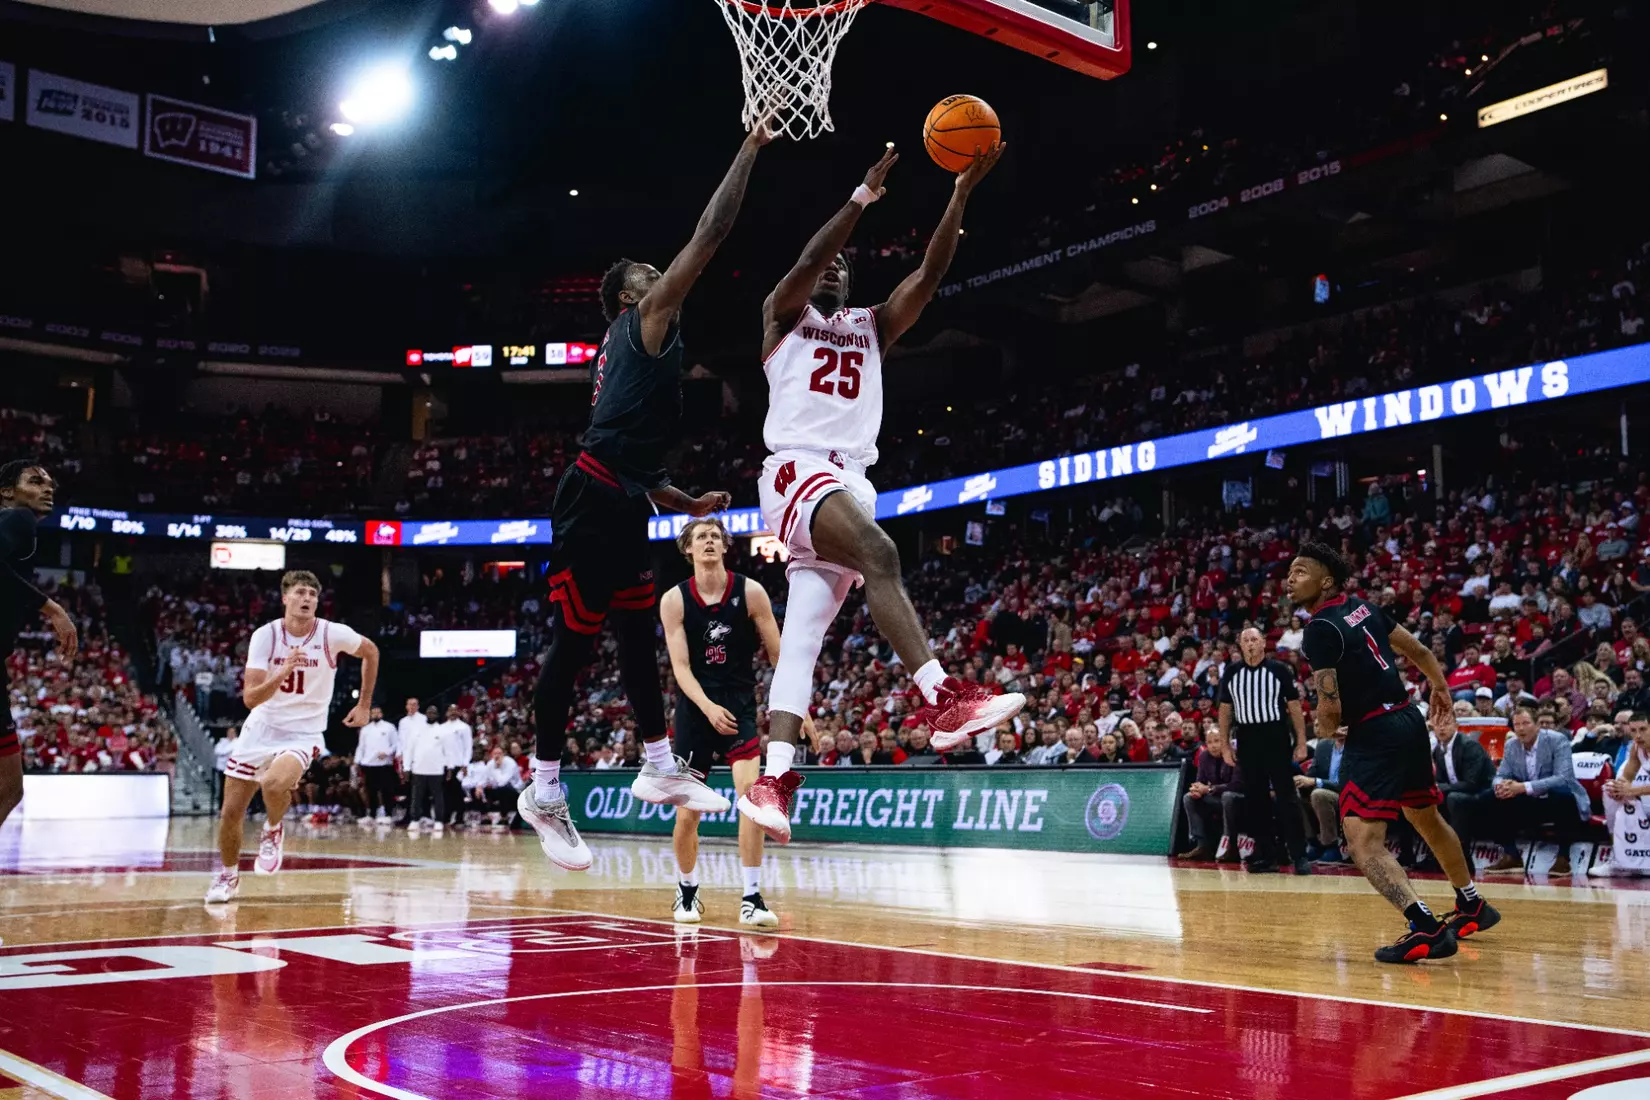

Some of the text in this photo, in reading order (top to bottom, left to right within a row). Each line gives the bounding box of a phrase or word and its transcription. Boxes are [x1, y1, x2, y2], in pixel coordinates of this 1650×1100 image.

[81, 107, 131, 129] 2015
[199, 139, 244, 161] 1941
[937, 161, 1342, 299] TEN TOURNAMENT CHAMPIONS 2004 2008 2015
[802, 325, 870, 349] WISCONSIN
[809, 347, 864, 400] 25
[1314, 360, 1570, 439] WINDOWS
[1038, 440, 1156, 490] SIDING
[60, 514, 146, 535] 5/10 50%
[167, 522, 202, 538] 5/14
[1362, 625, 1389, 670] 1
[584, 786, 634, 819] OLD
[791, 787, 944, 829] FREIGHT
[953, 789, 1049, 832] LINE
